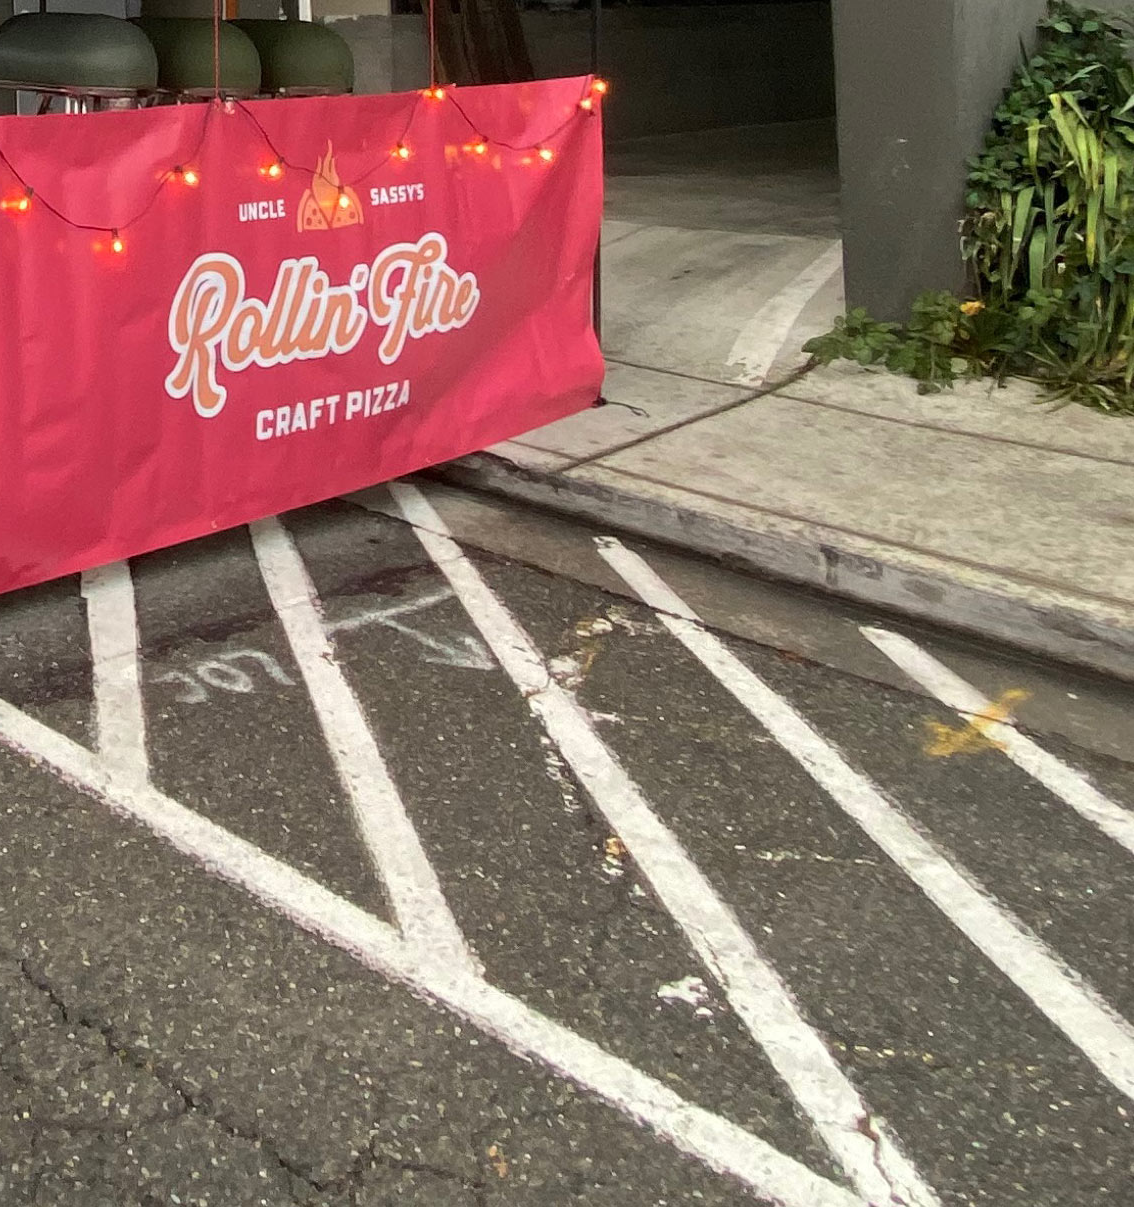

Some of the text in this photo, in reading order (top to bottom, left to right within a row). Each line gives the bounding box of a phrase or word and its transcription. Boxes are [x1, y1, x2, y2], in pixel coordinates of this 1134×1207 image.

[238, 183, 424, 222] UNCLE SASSY'S
[368, 232, 480, 365] Fire
[255, 380, 410, 441] CRAFT PIZZA
